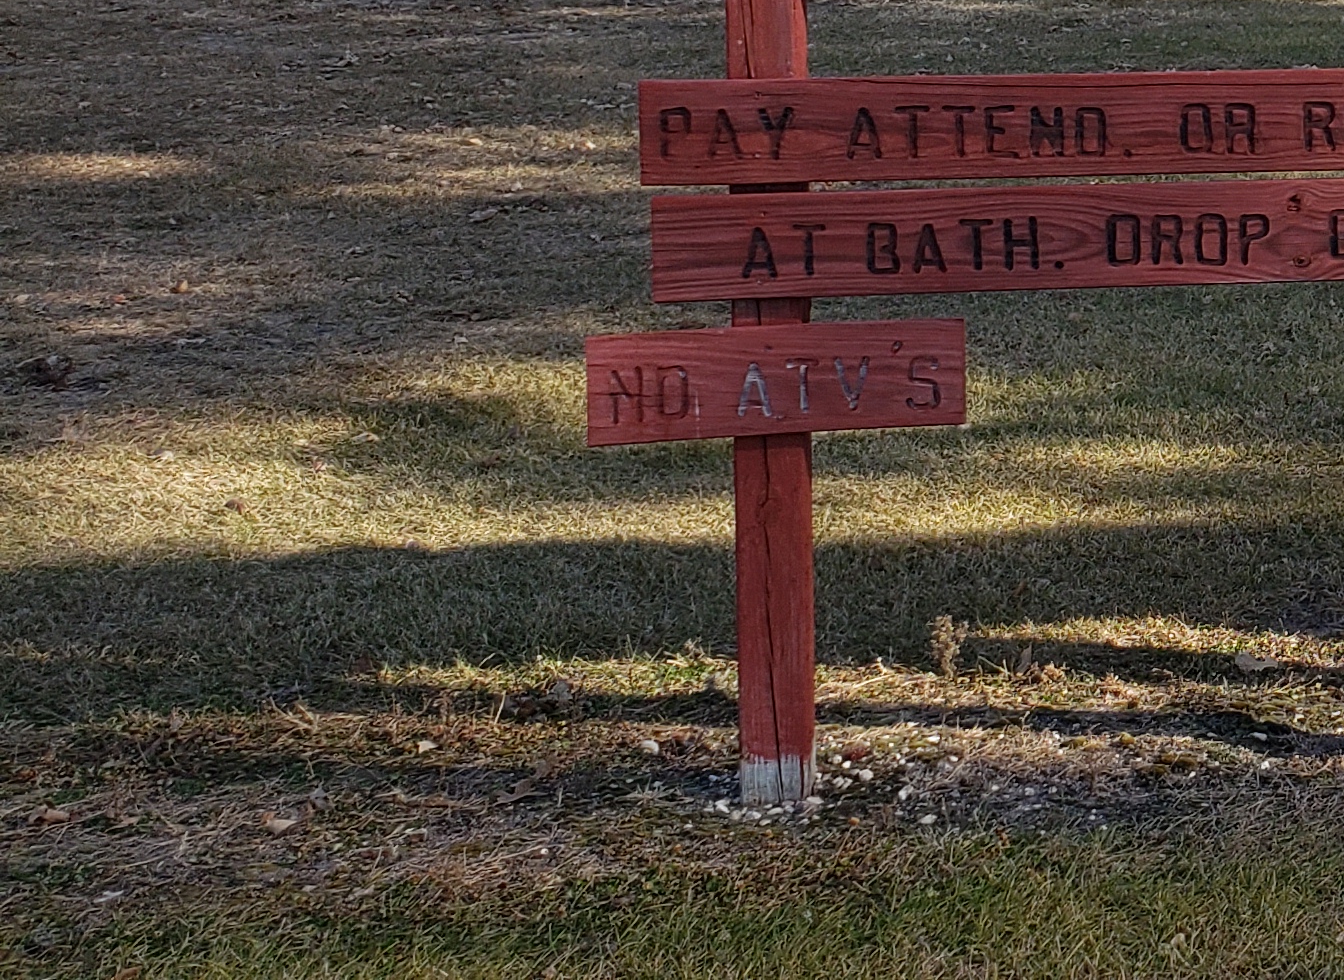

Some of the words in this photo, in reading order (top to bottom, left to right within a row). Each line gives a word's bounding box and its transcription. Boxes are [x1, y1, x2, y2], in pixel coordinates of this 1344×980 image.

[658, 104, 795, 163] PAY
[847, 103, 1133, 160] ATTEND.
[1179, 100, 1257, 155] OR
[742, 222, 826, 280] AT
[866, 217, 1067, 276] BATH.
[1107, 211, 1272, 268] DROP
[609, 365, 690, 425] NO
[737, 339, 943, 419] ATV'S
